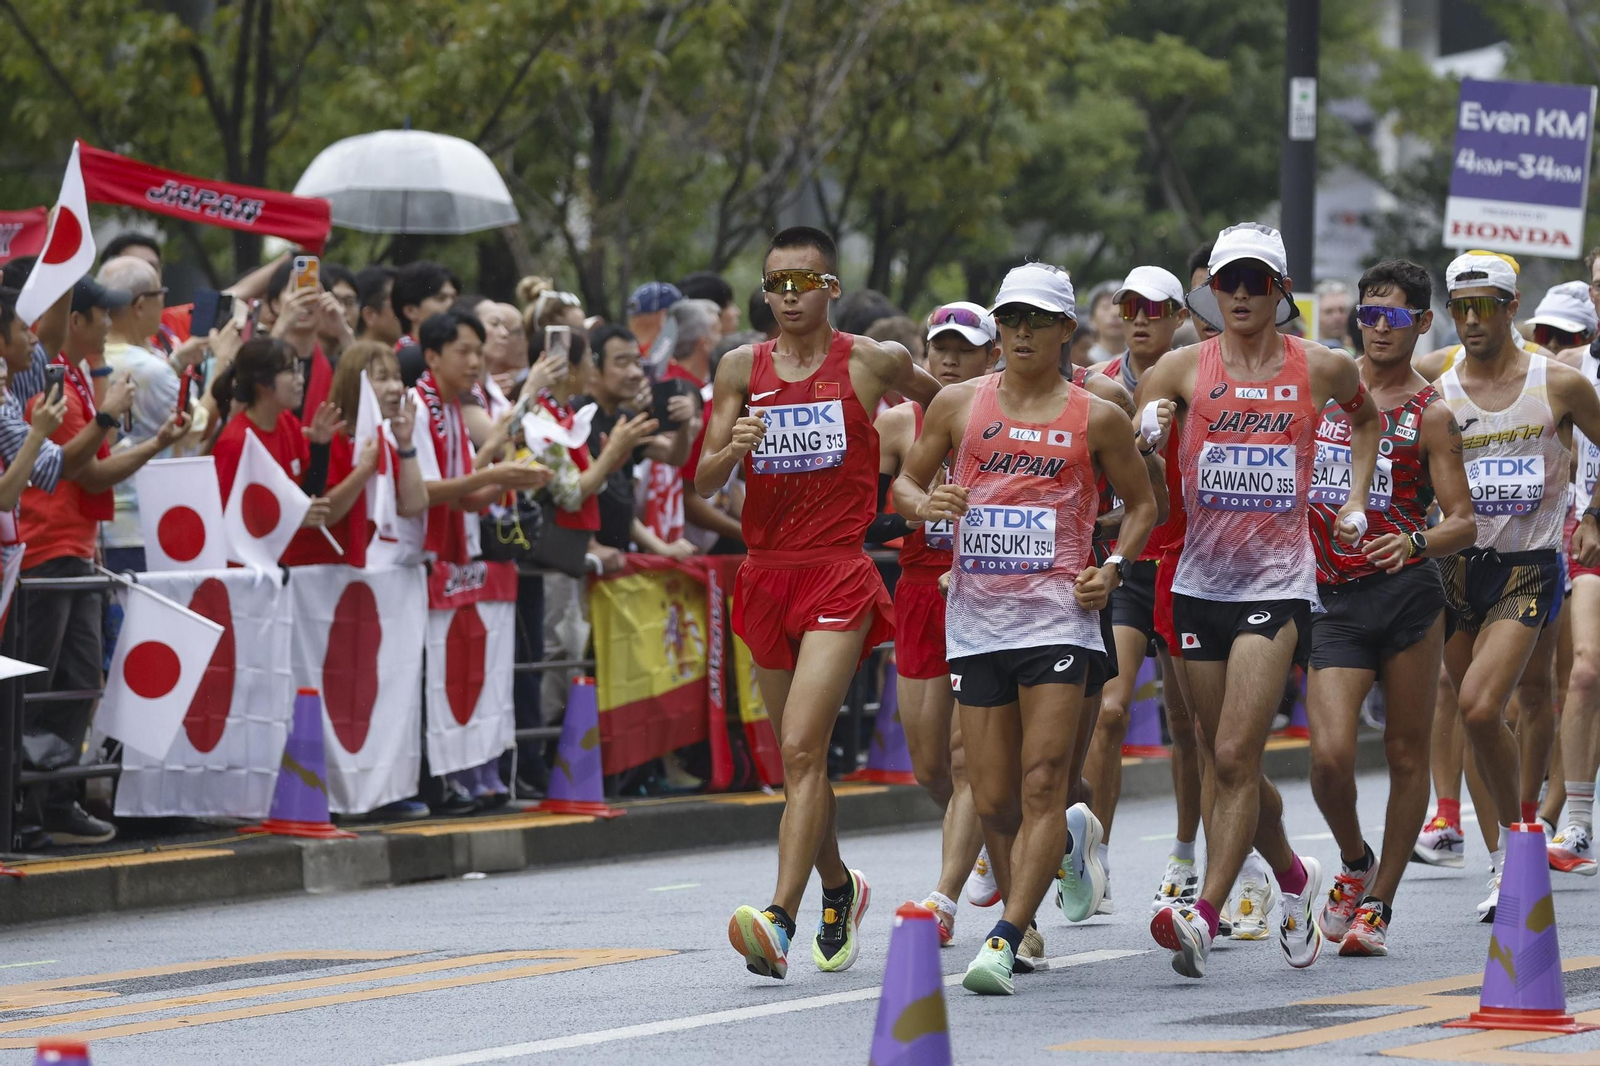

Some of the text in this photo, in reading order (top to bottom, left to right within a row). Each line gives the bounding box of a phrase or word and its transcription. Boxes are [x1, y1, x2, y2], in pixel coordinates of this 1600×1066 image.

[1460, 101, 1588, 140] Even KM
[146, 179, 265, 226] JAPAN
[1451, 219, 1572, 247] HONDA
[1237, 389, 1266, 399] ACN
[771, 404, 836, 428] TDK
[1209, 410, 1294, 433] JAPAN
[826, 433, 844, 450] 313
[1011, 430, 1039, 441] ACN
[1396, 427, 1414, 438] MEX
[1463, 425, 1544, 449] ESPAÑA
[979, 452, 1067, 479] JAPAN
[1226, 446, 1289, 467] TDK
[1480, 459, 1537, 476] TDK
[1201, 469, 1295, 494] KAWANO 355
[1311, 466, 1389, 494] SALAR
[1470, 482, 1543, 500] ÓPEZ 327
[1322, 491, 1347, 501] TOK
[984, 508, 1048, 530] TDK
[963, 533, 1053, 556] KATSUKI 354
[443, 561, 488, 597] JAPAN
